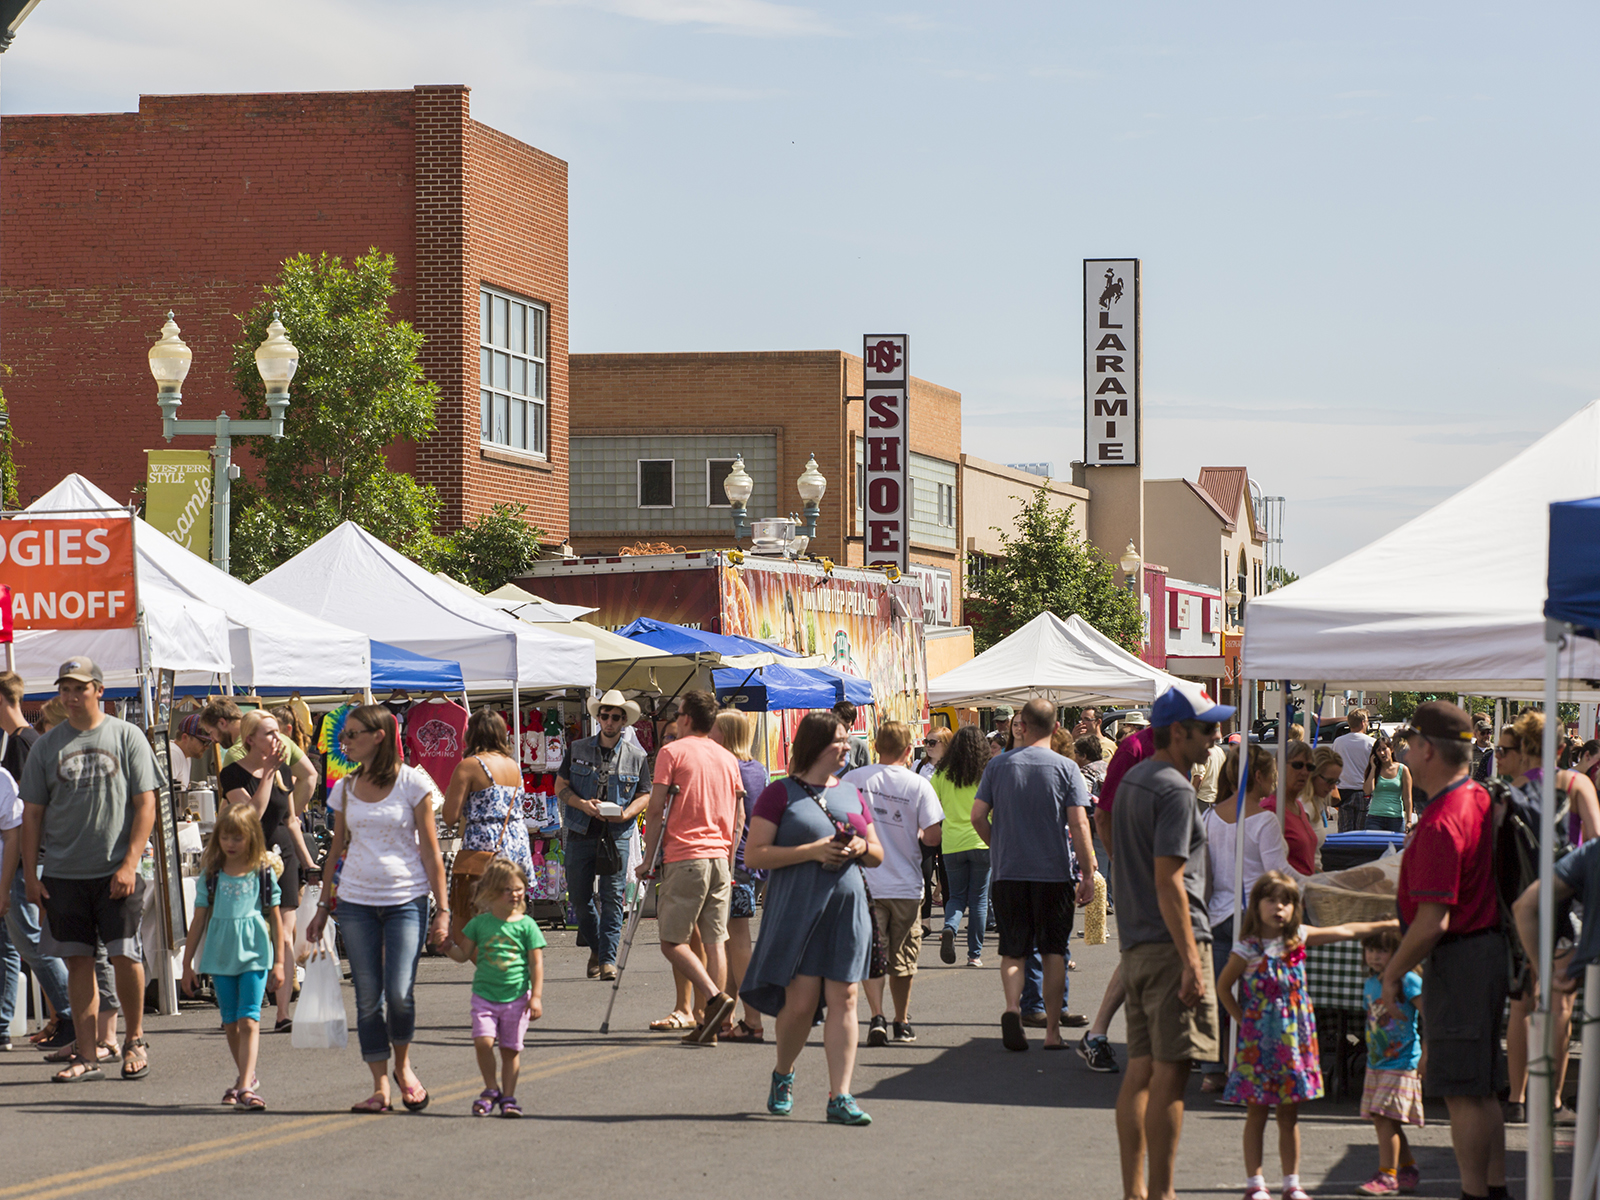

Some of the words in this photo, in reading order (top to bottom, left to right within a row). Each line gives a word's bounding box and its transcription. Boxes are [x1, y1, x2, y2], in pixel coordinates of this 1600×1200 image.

[1094, 311, 1128, 460] LARAMIE
[148, 472, 185, 484] STYLE
[150, 464, 211, 473] WESTERN
[867, 395, 901, 569] SHOE
[166, 477, 211, 550] ramie
[0, 528, 110, 567] GIES
